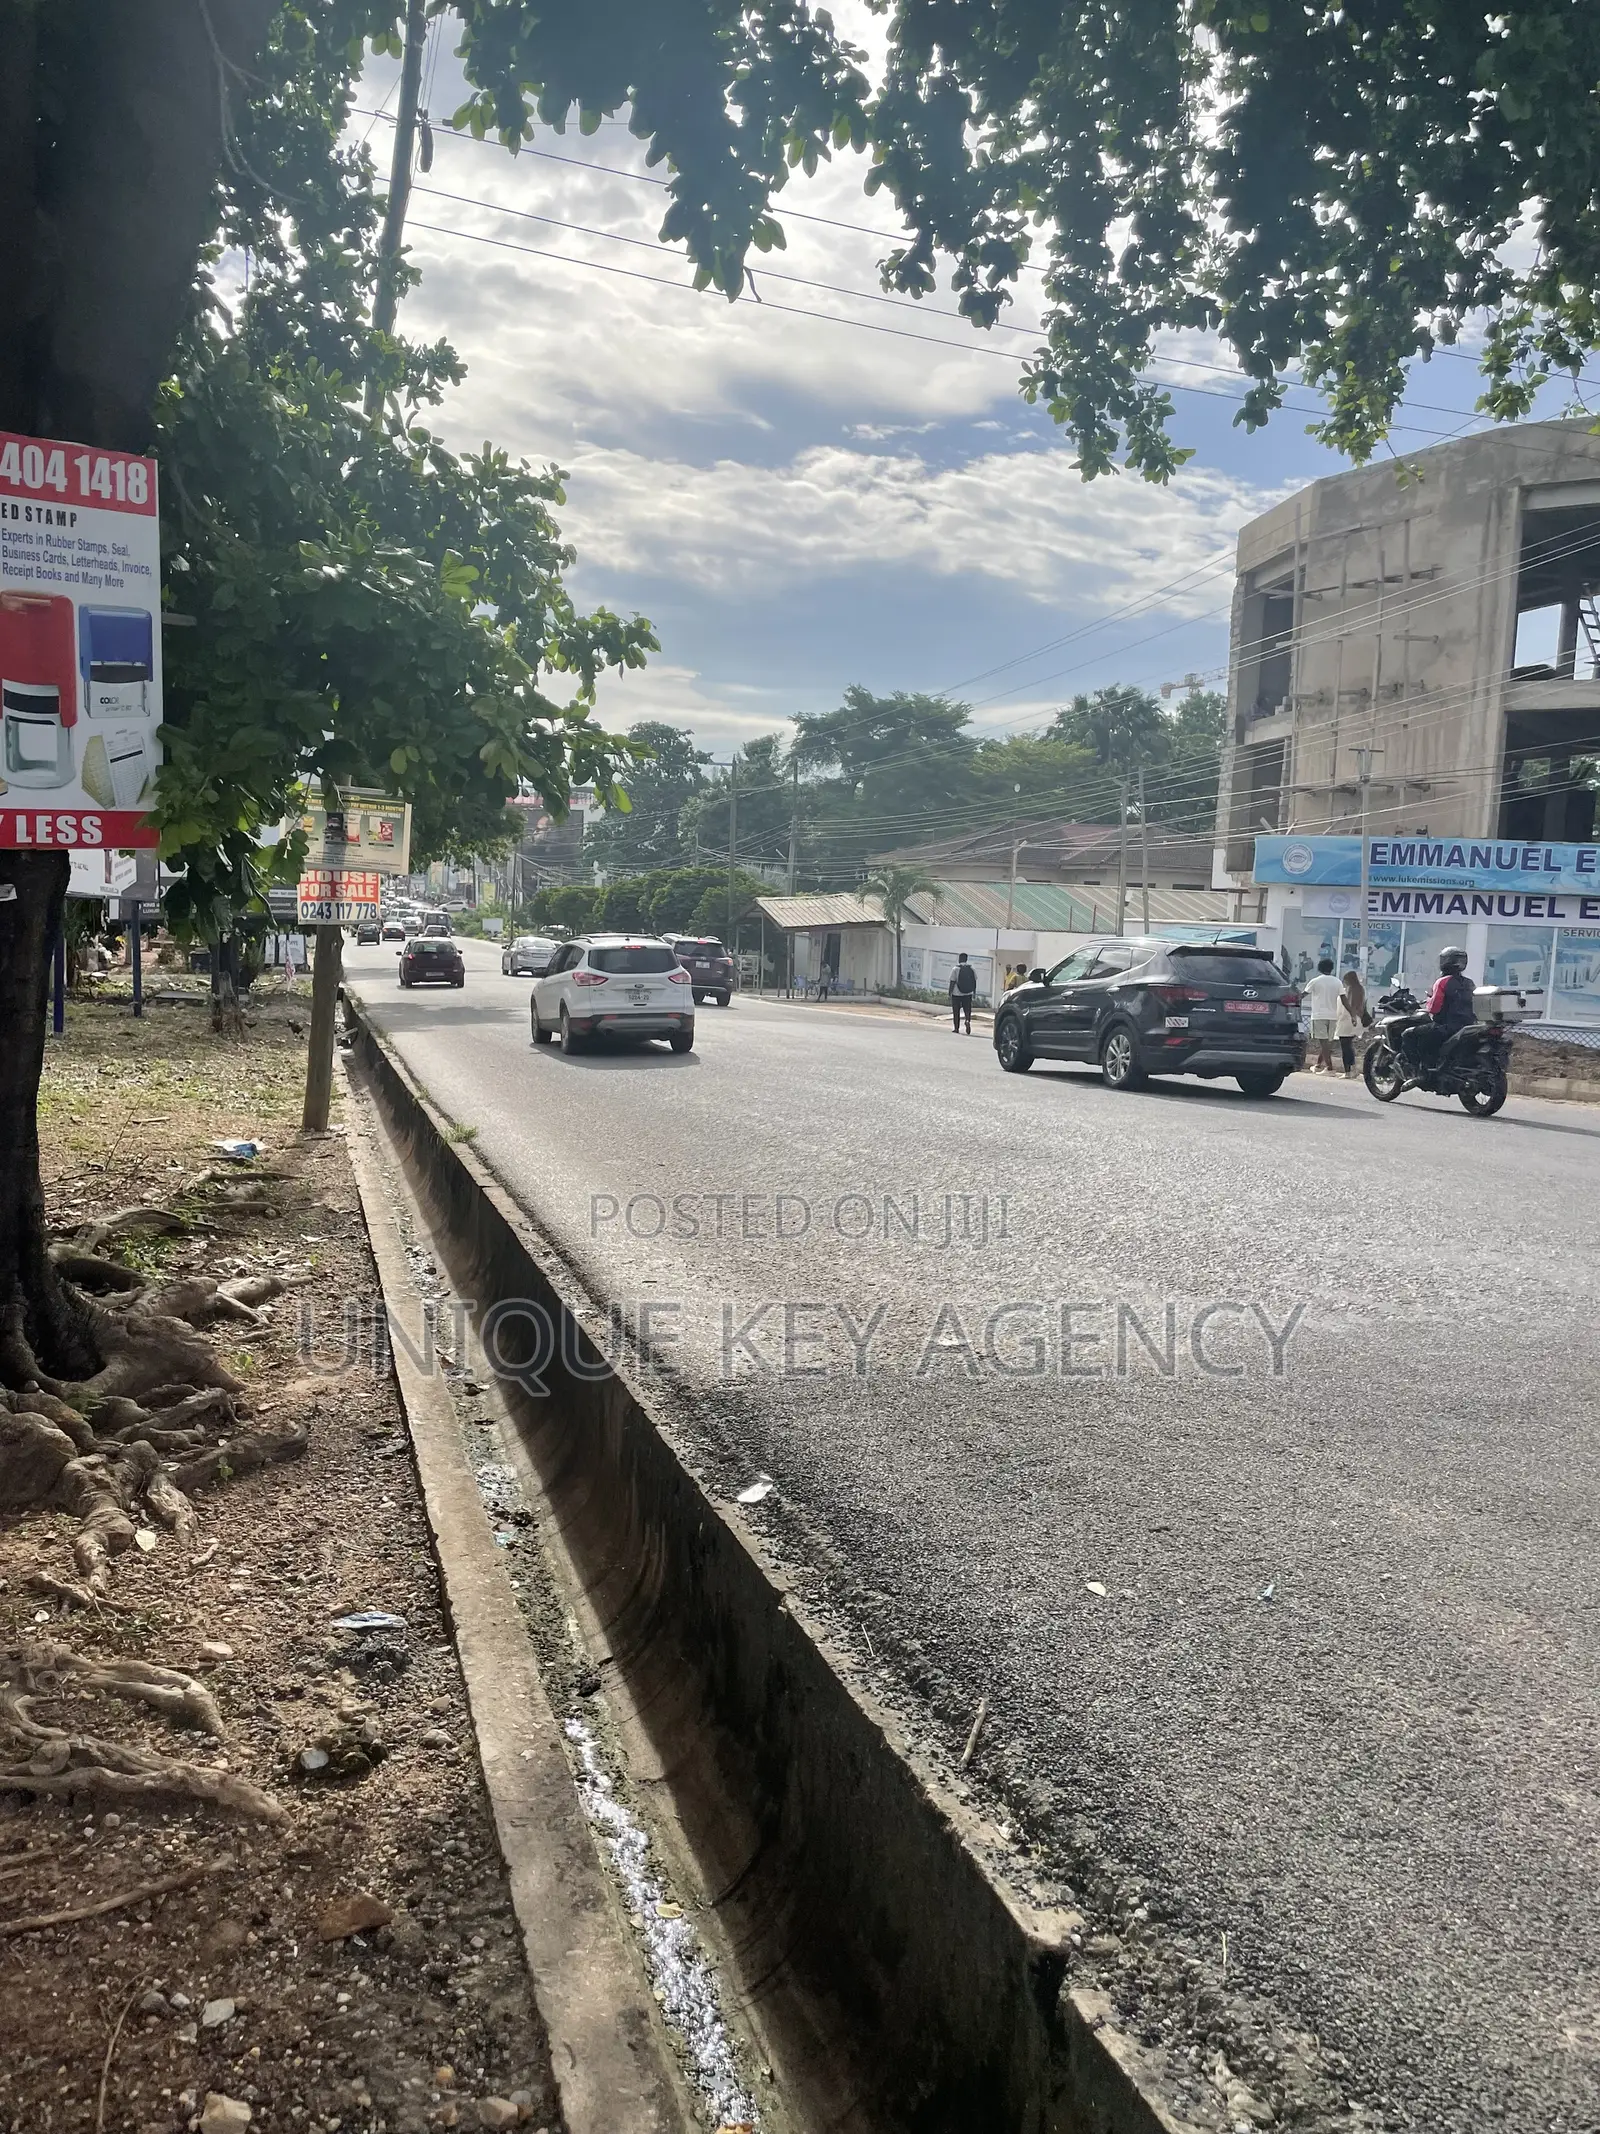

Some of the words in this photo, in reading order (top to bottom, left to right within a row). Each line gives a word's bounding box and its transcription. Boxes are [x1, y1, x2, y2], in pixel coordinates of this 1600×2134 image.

[0, 441, 68, 493] 404
[75, 454, 148, 505] 1418
[25, 505, 78, 528] STAMP
[1, 528, 34, 545] Experts
[36, 532, 44, 546] in
[45, 534, 76, 550] Rubber
[77, 538, 110, 555] Stamps,
[111, 543, 131, 557] Seal,
[2, 545, 41, 561] Business
[42, 550, 69, 567] Cards,
[71, 554, 120, 573] Letterheads,
[121, 560, 152, 578] Invoice,
[2, 562, 34, 580] Receipt
[36, 566, 62, 581] Books
[64, 571, 80, 583] and
[81, 572, 103, 588] Many
[104, 574, 125, 588] More
[15, 814, 104, 845] LESS
[1370, 842, 1562, 873] EMMANUEL
[1575, 848, 1598, 873] E
[300, 869, 378, 884] HOUSE
[1373, 875, 1475, 888] www.lukemissions.org
[300, 882, 332, 898] FOR
[335, 883, 375, 898] SALE
[301, 901, 332, 920] 0243
[335, 902, 353, 920] 117
[355, 902, 378, 920] 778
[1368, 891, 1566, 919] EMMANUEL
[1352, 921, 1392, 930] SEVICES
